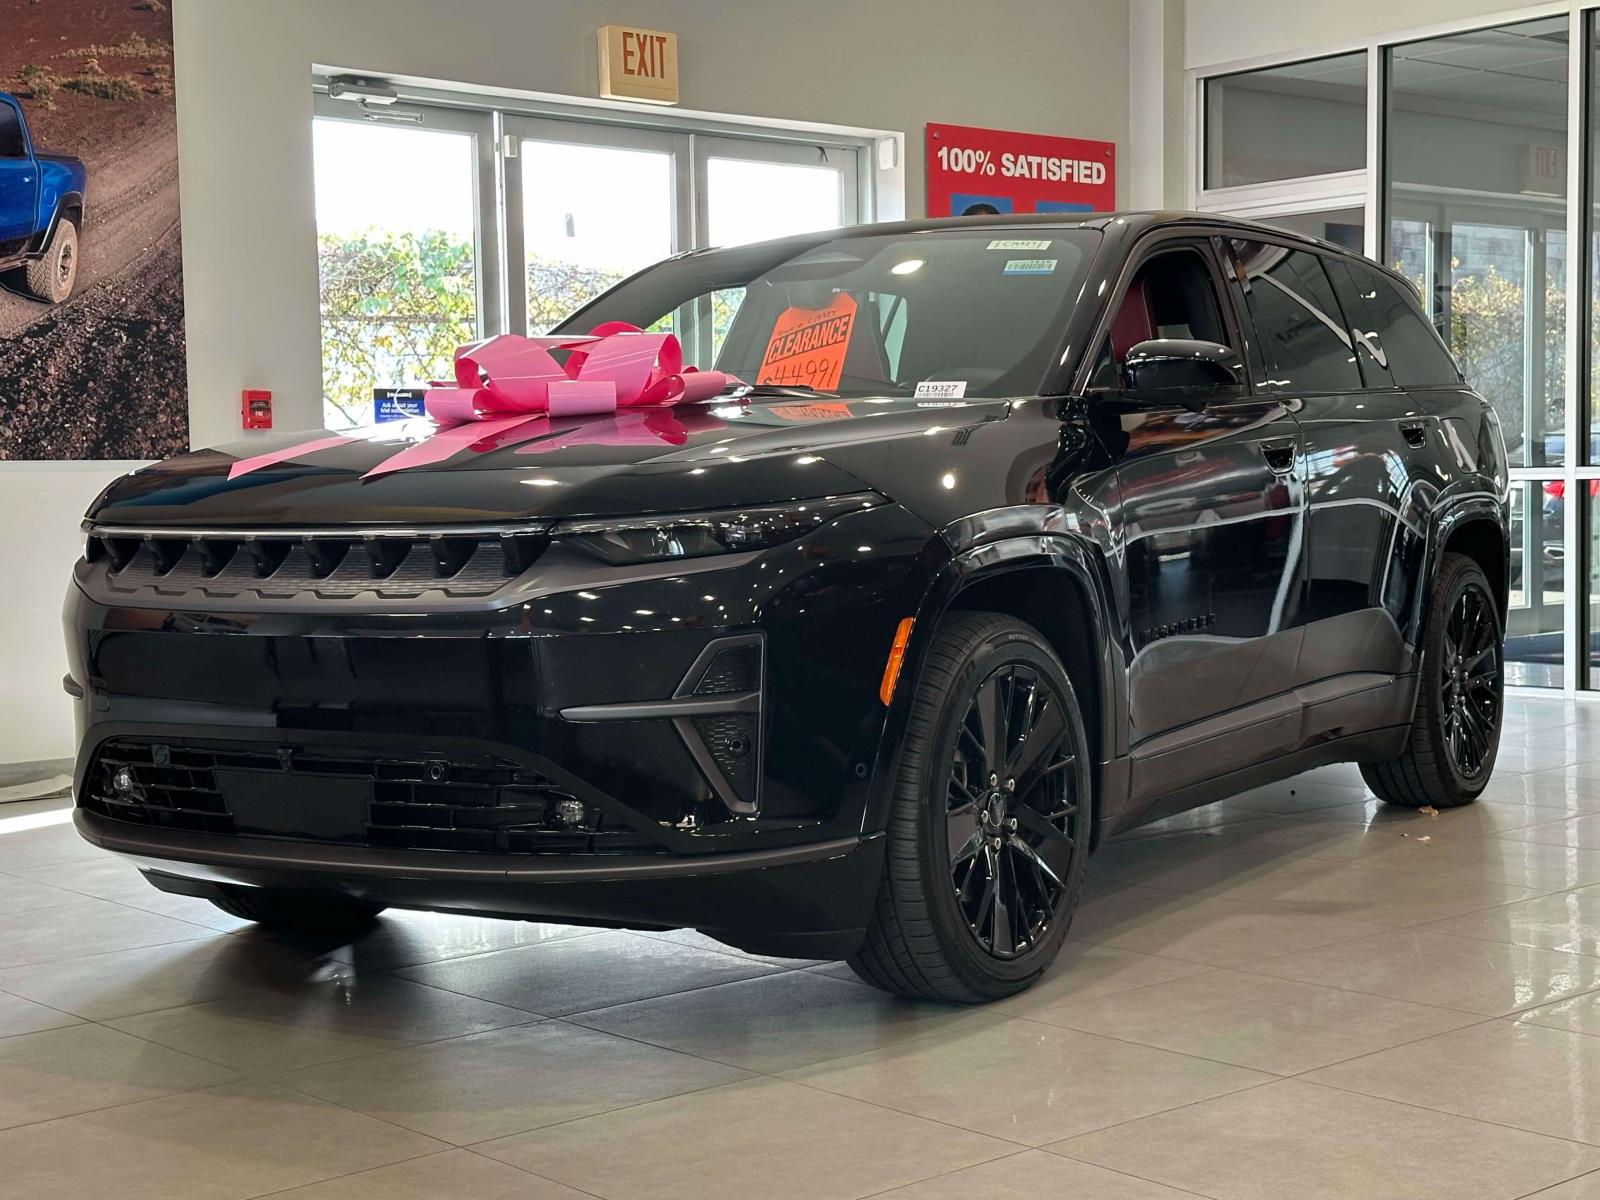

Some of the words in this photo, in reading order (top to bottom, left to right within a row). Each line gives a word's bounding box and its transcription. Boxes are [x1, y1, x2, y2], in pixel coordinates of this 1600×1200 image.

[622, 31, 667, 80] EXIT
[937, 146, 996, 176] 100%
[1001, 153, 1106, 185] SATISFIED
[767, 316, 850, 364] CLEARANCE
[918, 384, 958, 393] C19327
